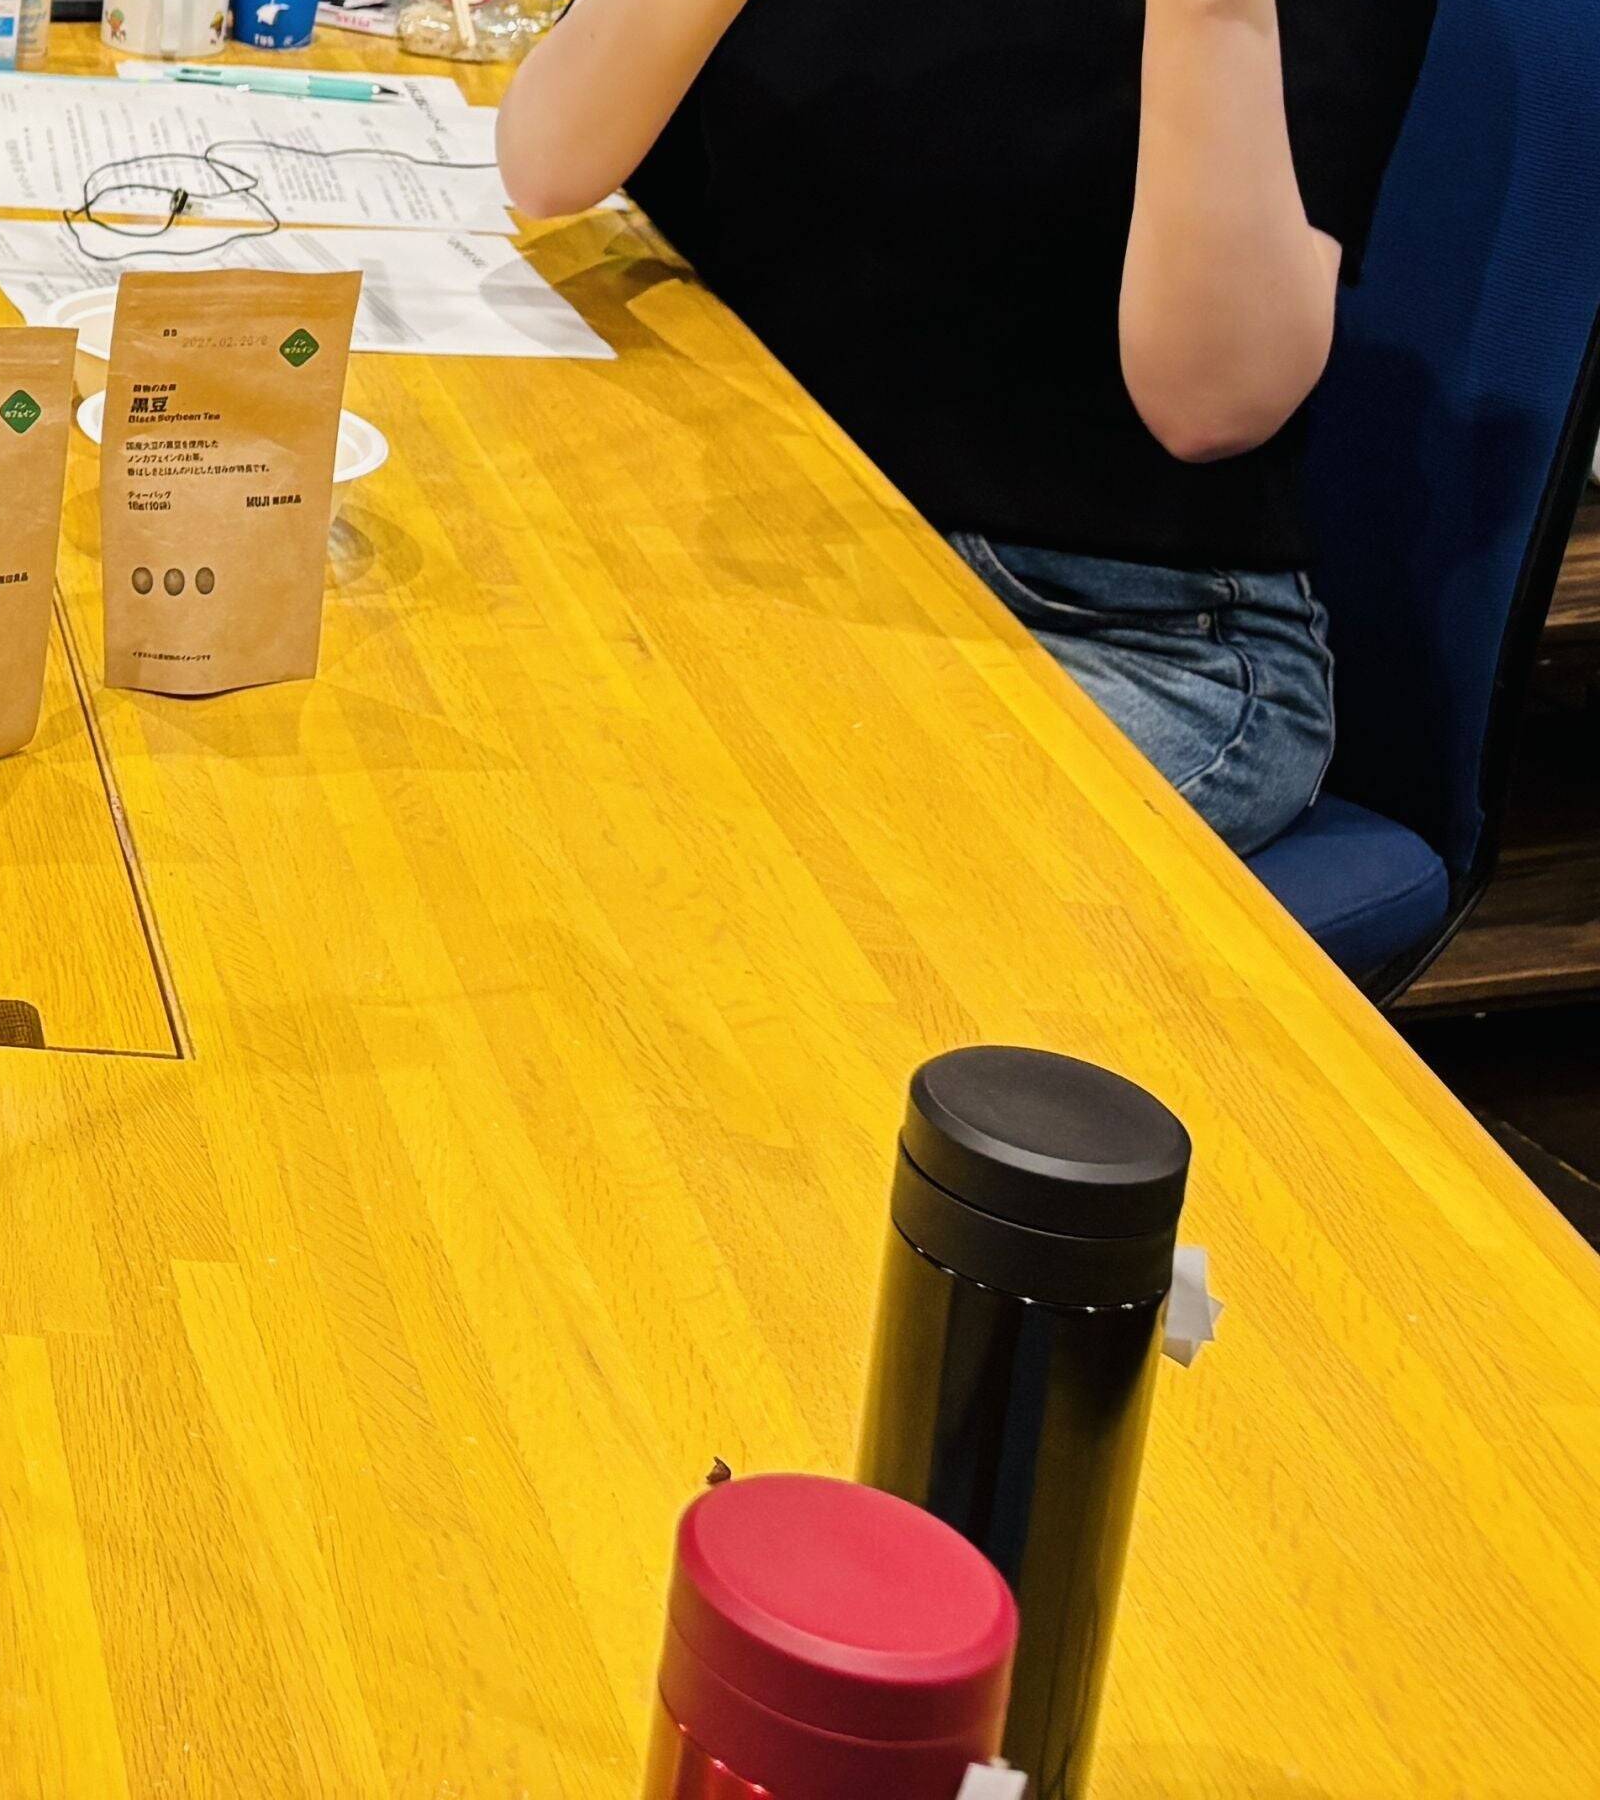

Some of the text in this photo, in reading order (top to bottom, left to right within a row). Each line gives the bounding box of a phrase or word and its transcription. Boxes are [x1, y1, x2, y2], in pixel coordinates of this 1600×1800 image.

[131, 396, 168, 413] 黒豆
[128, 414, 156, 423] Black
[203, 412, 220, 420] Tea
[246, 496, 270, 507] MUJI
